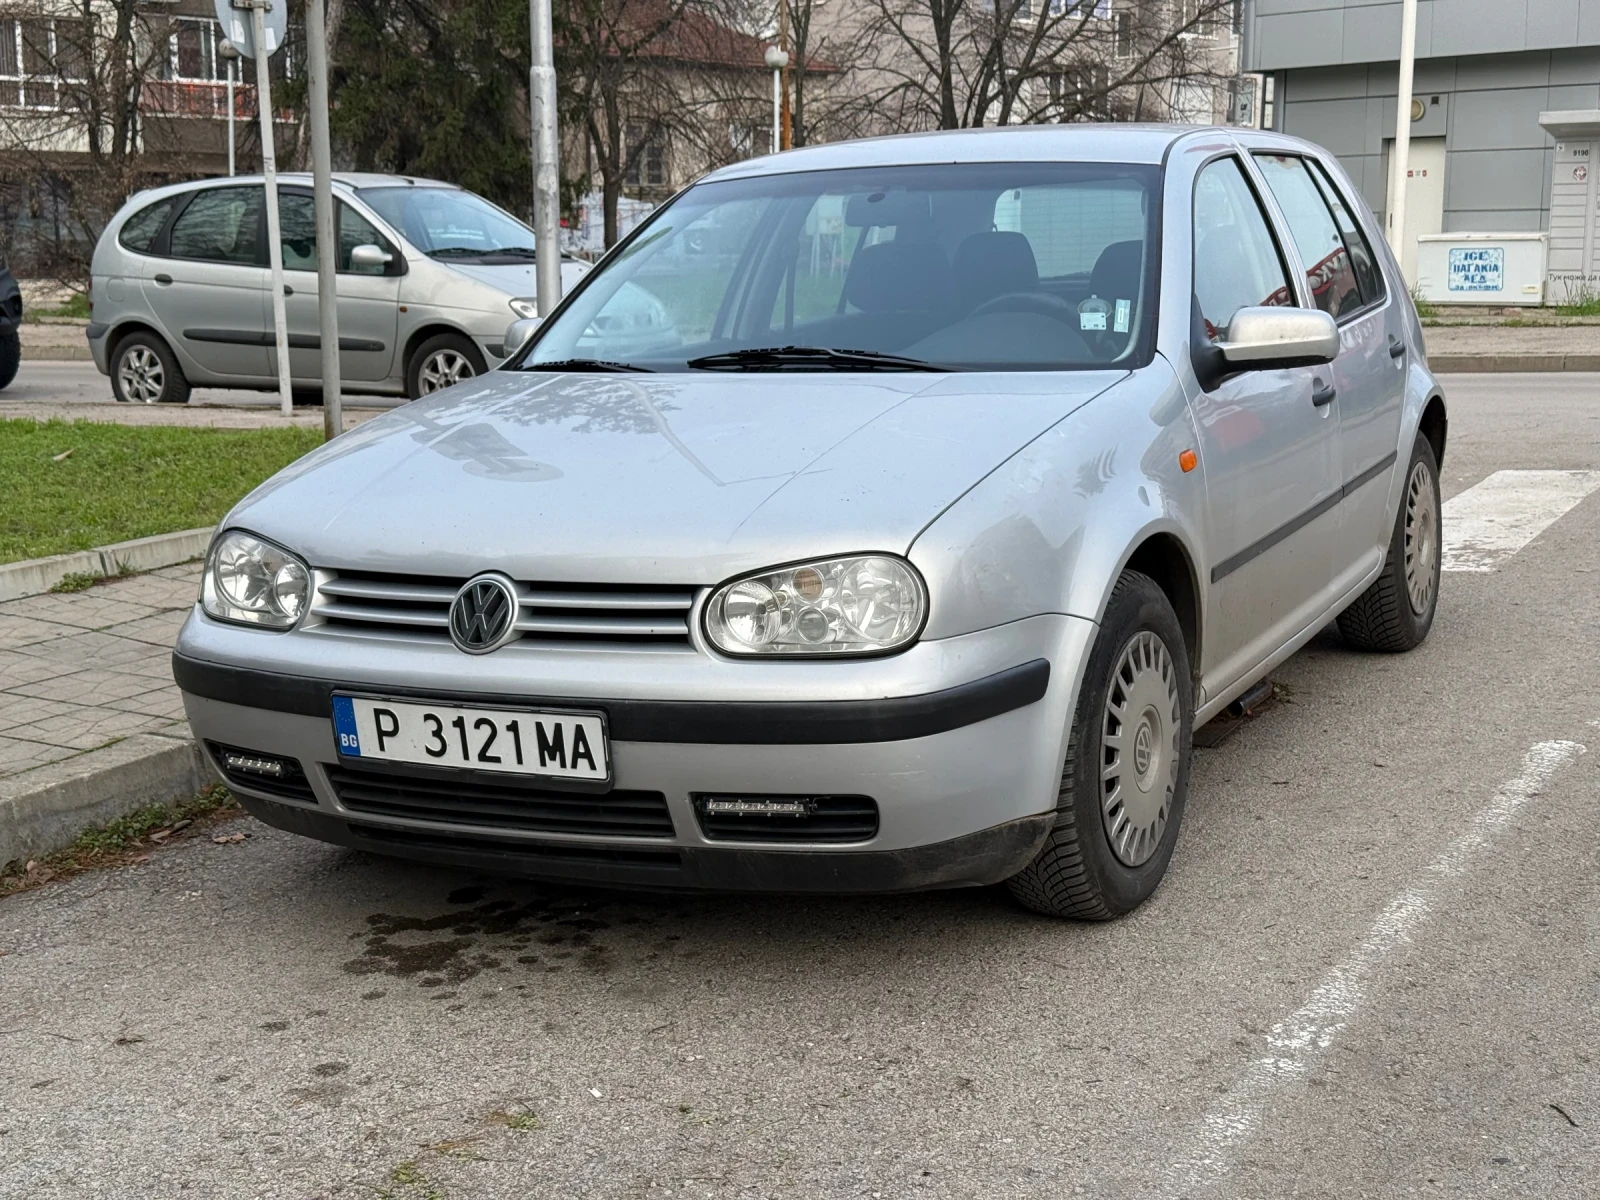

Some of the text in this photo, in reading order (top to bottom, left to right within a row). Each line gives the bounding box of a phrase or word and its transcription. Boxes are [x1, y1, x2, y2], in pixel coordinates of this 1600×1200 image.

[1464, 251, 1489, 261] ICE
[341, 733, 358, 748] BG
[373, 707, 598, 771] P 3121 MA
